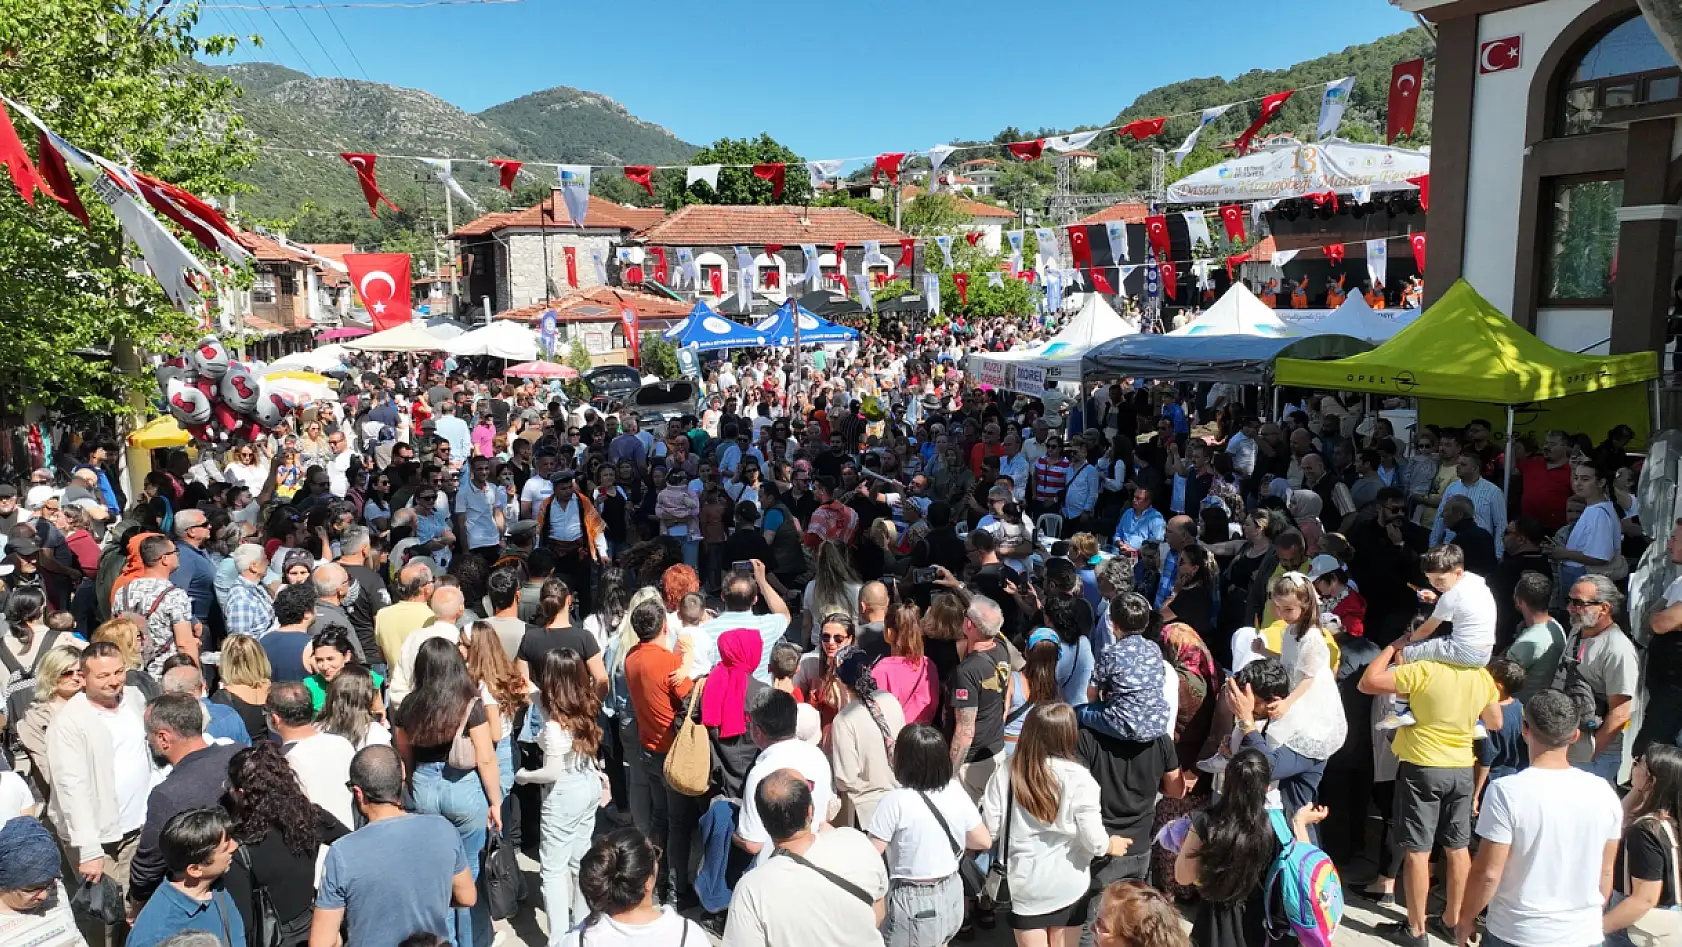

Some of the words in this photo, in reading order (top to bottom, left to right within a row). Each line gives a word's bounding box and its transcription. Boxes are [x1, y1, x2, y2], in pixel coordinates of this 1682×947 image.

[1293, 146, 1317, 175] 13
[1017, 366, 1043, 383] MOREL
[1347, 374, 1386, 385] OPEL
